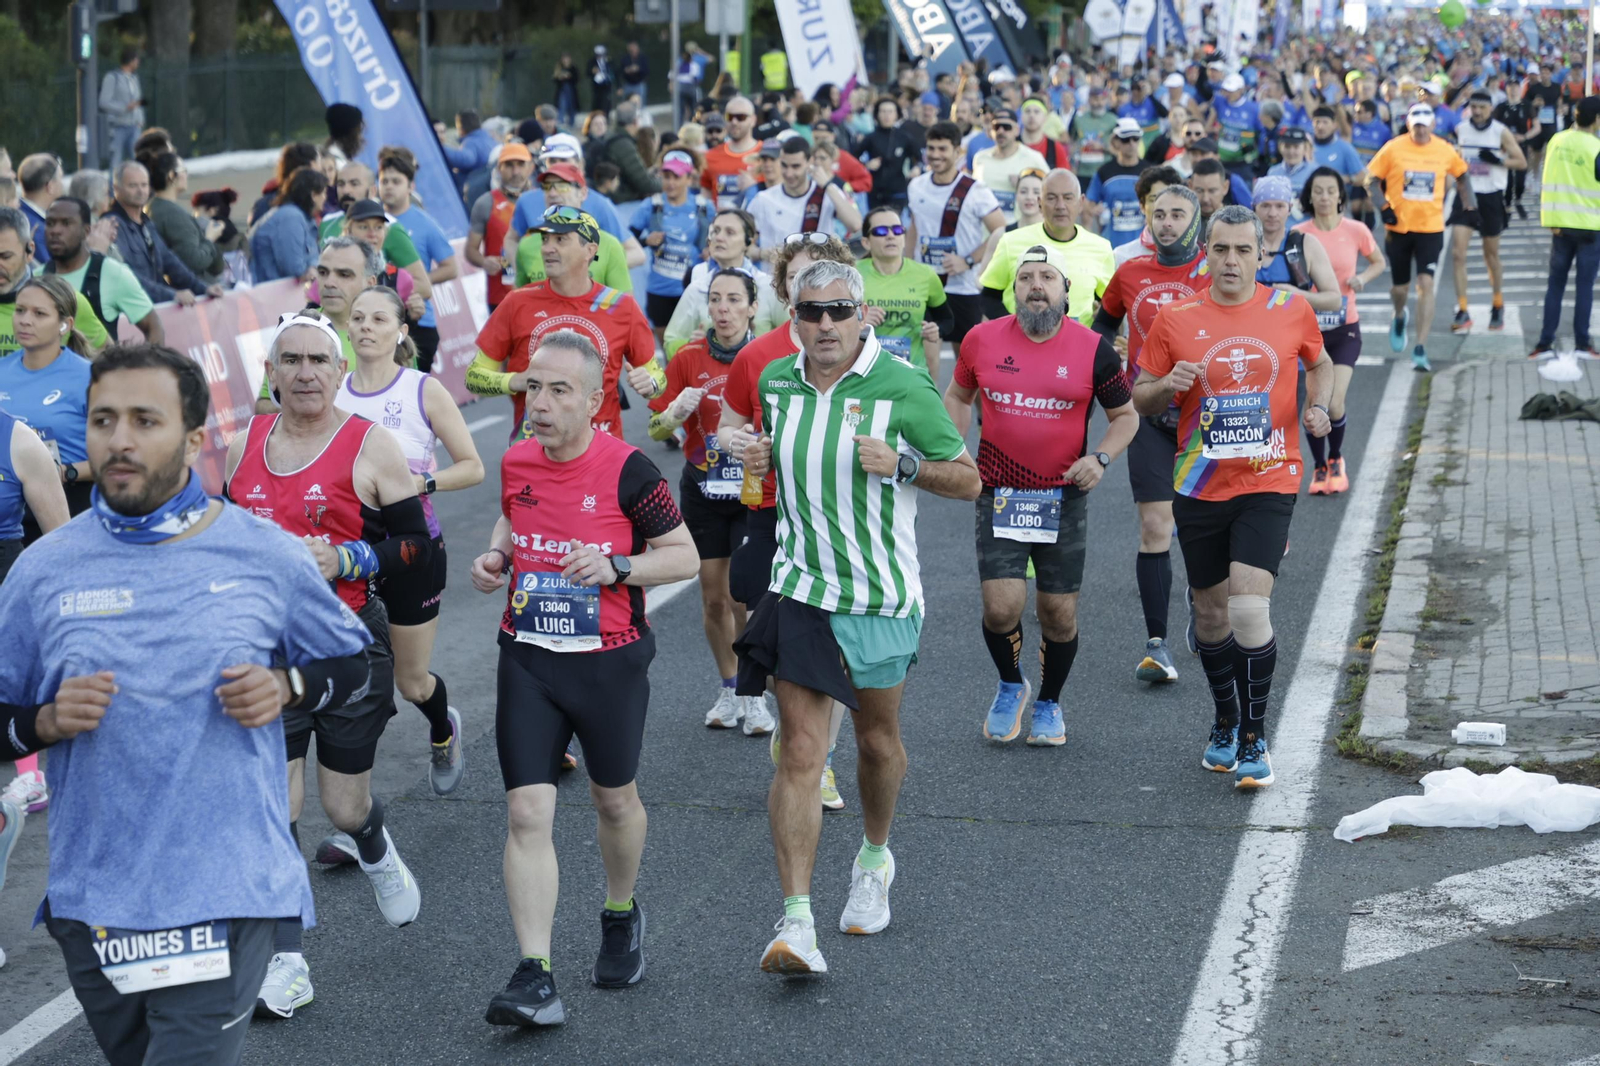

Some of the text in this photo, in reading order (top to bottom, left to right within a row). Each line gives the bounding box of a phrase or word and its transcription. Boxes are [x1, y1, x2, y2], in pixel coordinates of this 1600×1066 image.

[877, 299, 921, 308] RUNNING
[983, 387, 1076, 411] Los Lentos
[1222, 396, 1261, 408] ZURICH
[994, 405, 1061, 420] CLUB DE ATLETISMO
[1222, 416, 1249, 427] 13323
[1210, 426, 1264, 444] CHACÓN
[1015, 503, 1039, 512] 13462
[1010, 514, 1042, 528] LOBO
[531, 533, 613, 555] Lenos
[541, 577, 589, 589] ZURI
[539, 601, 570, 613] 13040
[534, 617, 575, 634] LUIGI
[92, 925, 227, 966] YOUNES EL.
